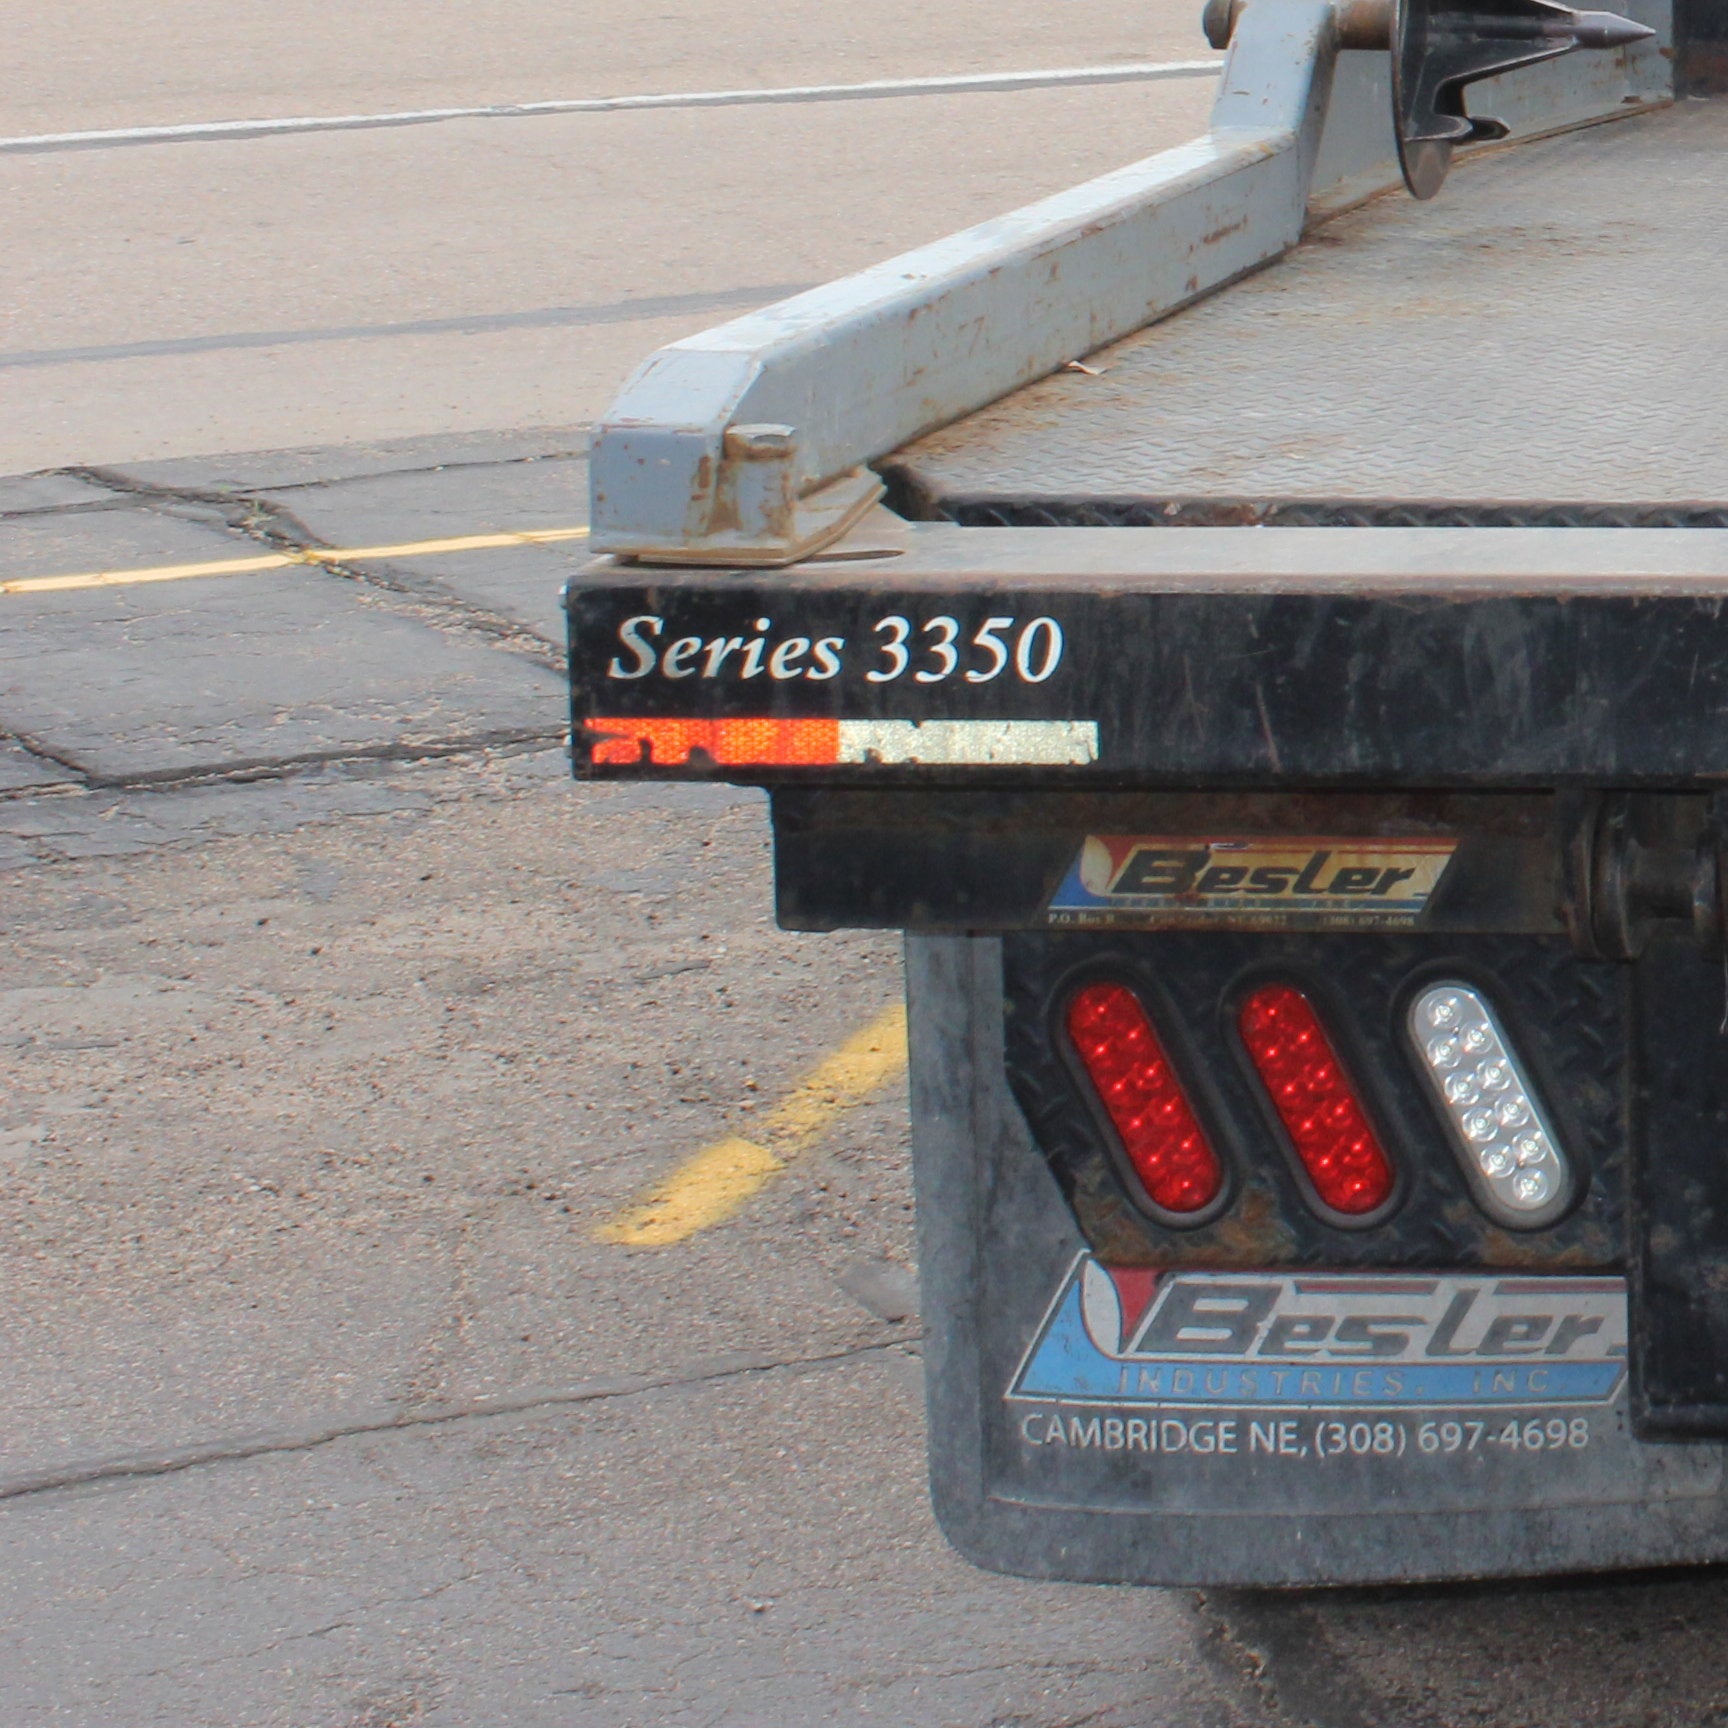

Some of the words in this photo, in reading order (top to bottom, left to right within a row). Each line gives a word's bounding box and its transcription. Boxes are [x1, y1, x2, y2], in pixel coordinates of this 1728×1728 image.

[607, 614, 846, 680] Series
[866, 615, 1064, 683] 3350
[1111, 849, 1417, 895] Besler
[1135, 1282, 1605, 1356] Besler
[1021, 1413, 1238, 1454] CAMBRIDGE
[1249, 1421, 1308, 1459] NE,
[1314, 1421, 1407, 1459] (308)
[1417, 1418, 1590, 1454] 697-4698
